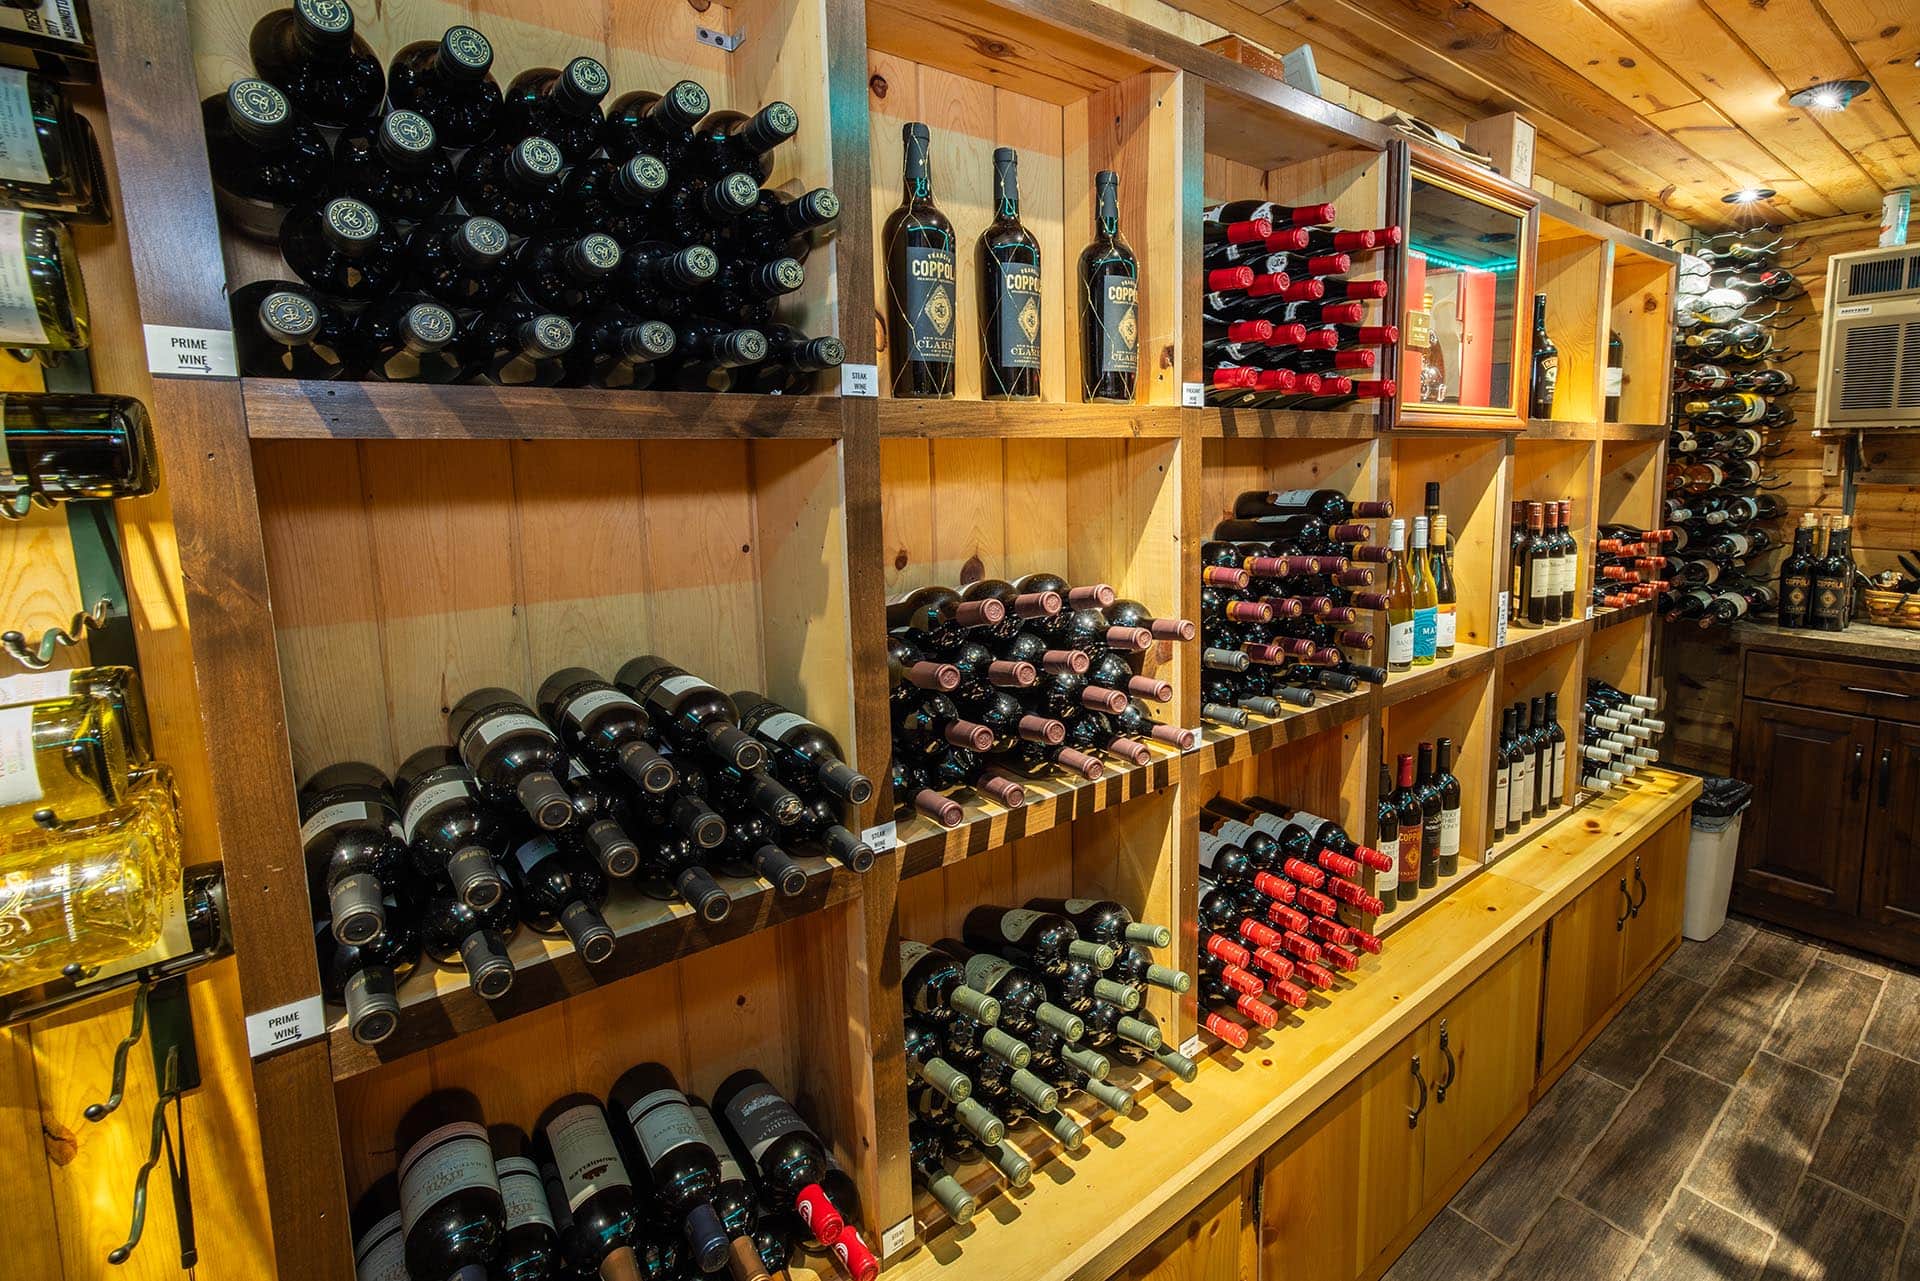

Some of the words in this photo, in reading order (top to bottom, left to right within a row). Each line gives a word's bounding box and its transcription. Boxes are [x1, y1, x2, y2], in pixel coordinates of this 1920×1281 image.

[23, 9, 43, 32] RIES
[56, 0, 77, 39] WASHINGTO
[912, 259, 954, 281] COPPOL
[1007, 274, 1040, 293] COPPO
[171, 337, 208, 350] PRIME
[178, 354, 208, 366] WINE
[852, 372, 867, 380] STEAK
[854, 383, 867, 391] WINE
[1422, 627, 1438, 635] MA
[268, 1011, 300, 1028] PRIME
[274, 1025, 300, 1040] WINE
